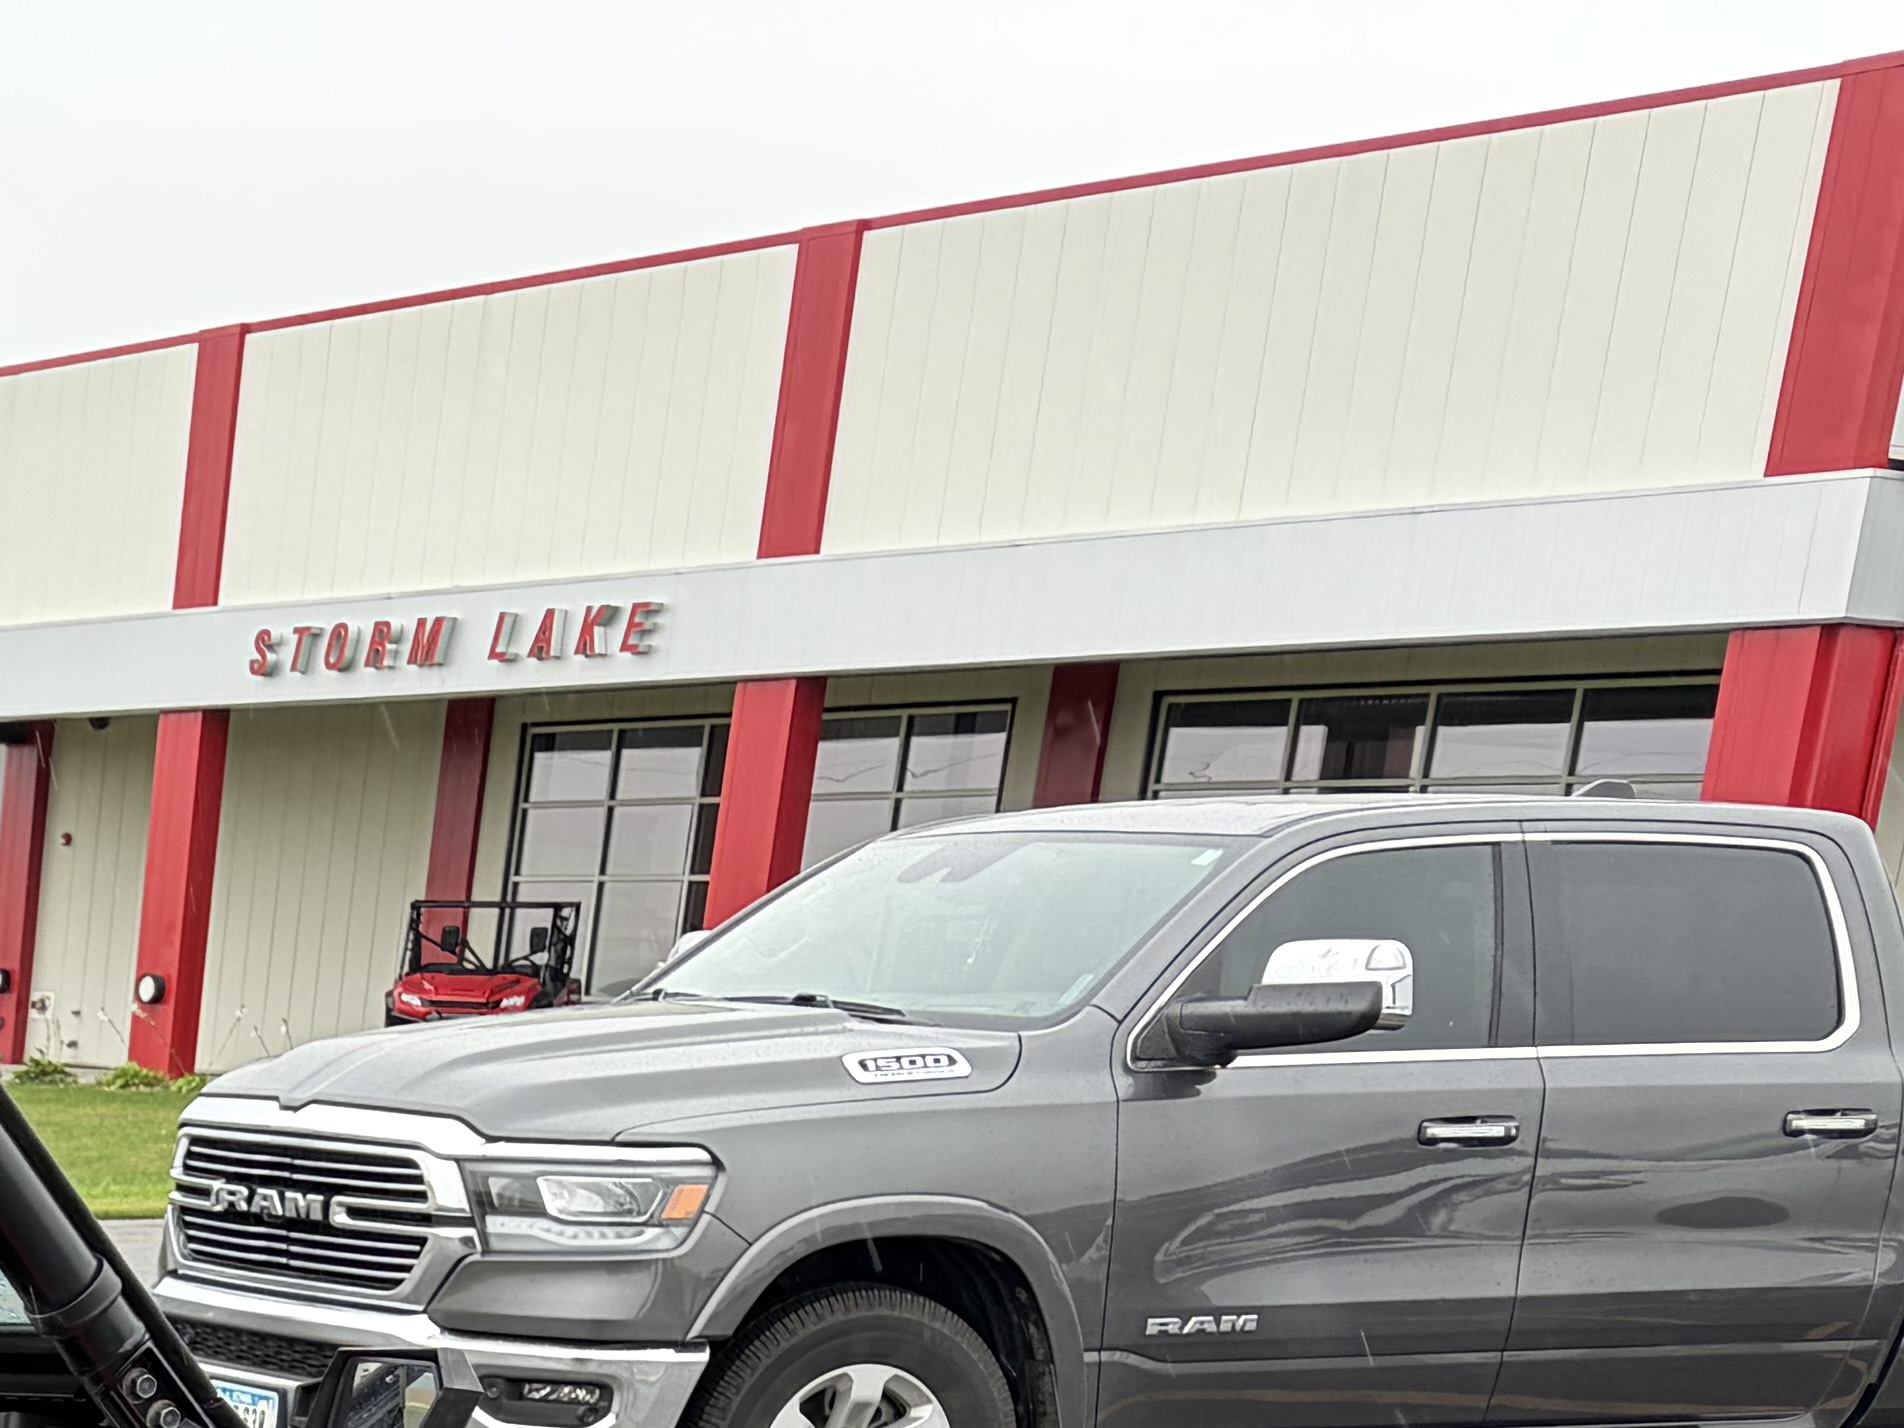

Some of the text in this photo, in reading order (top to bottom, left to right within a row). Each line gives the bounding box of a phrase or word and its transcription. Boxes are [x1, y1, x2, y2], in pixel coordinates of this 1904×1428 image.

[248, 602, 663, 677] STORM LAKE
[864, 1053, 950, 1073] 1500
[217, 1182, 324, 1221] RAM
[1145, 1314, 1259, 1335] RAM
